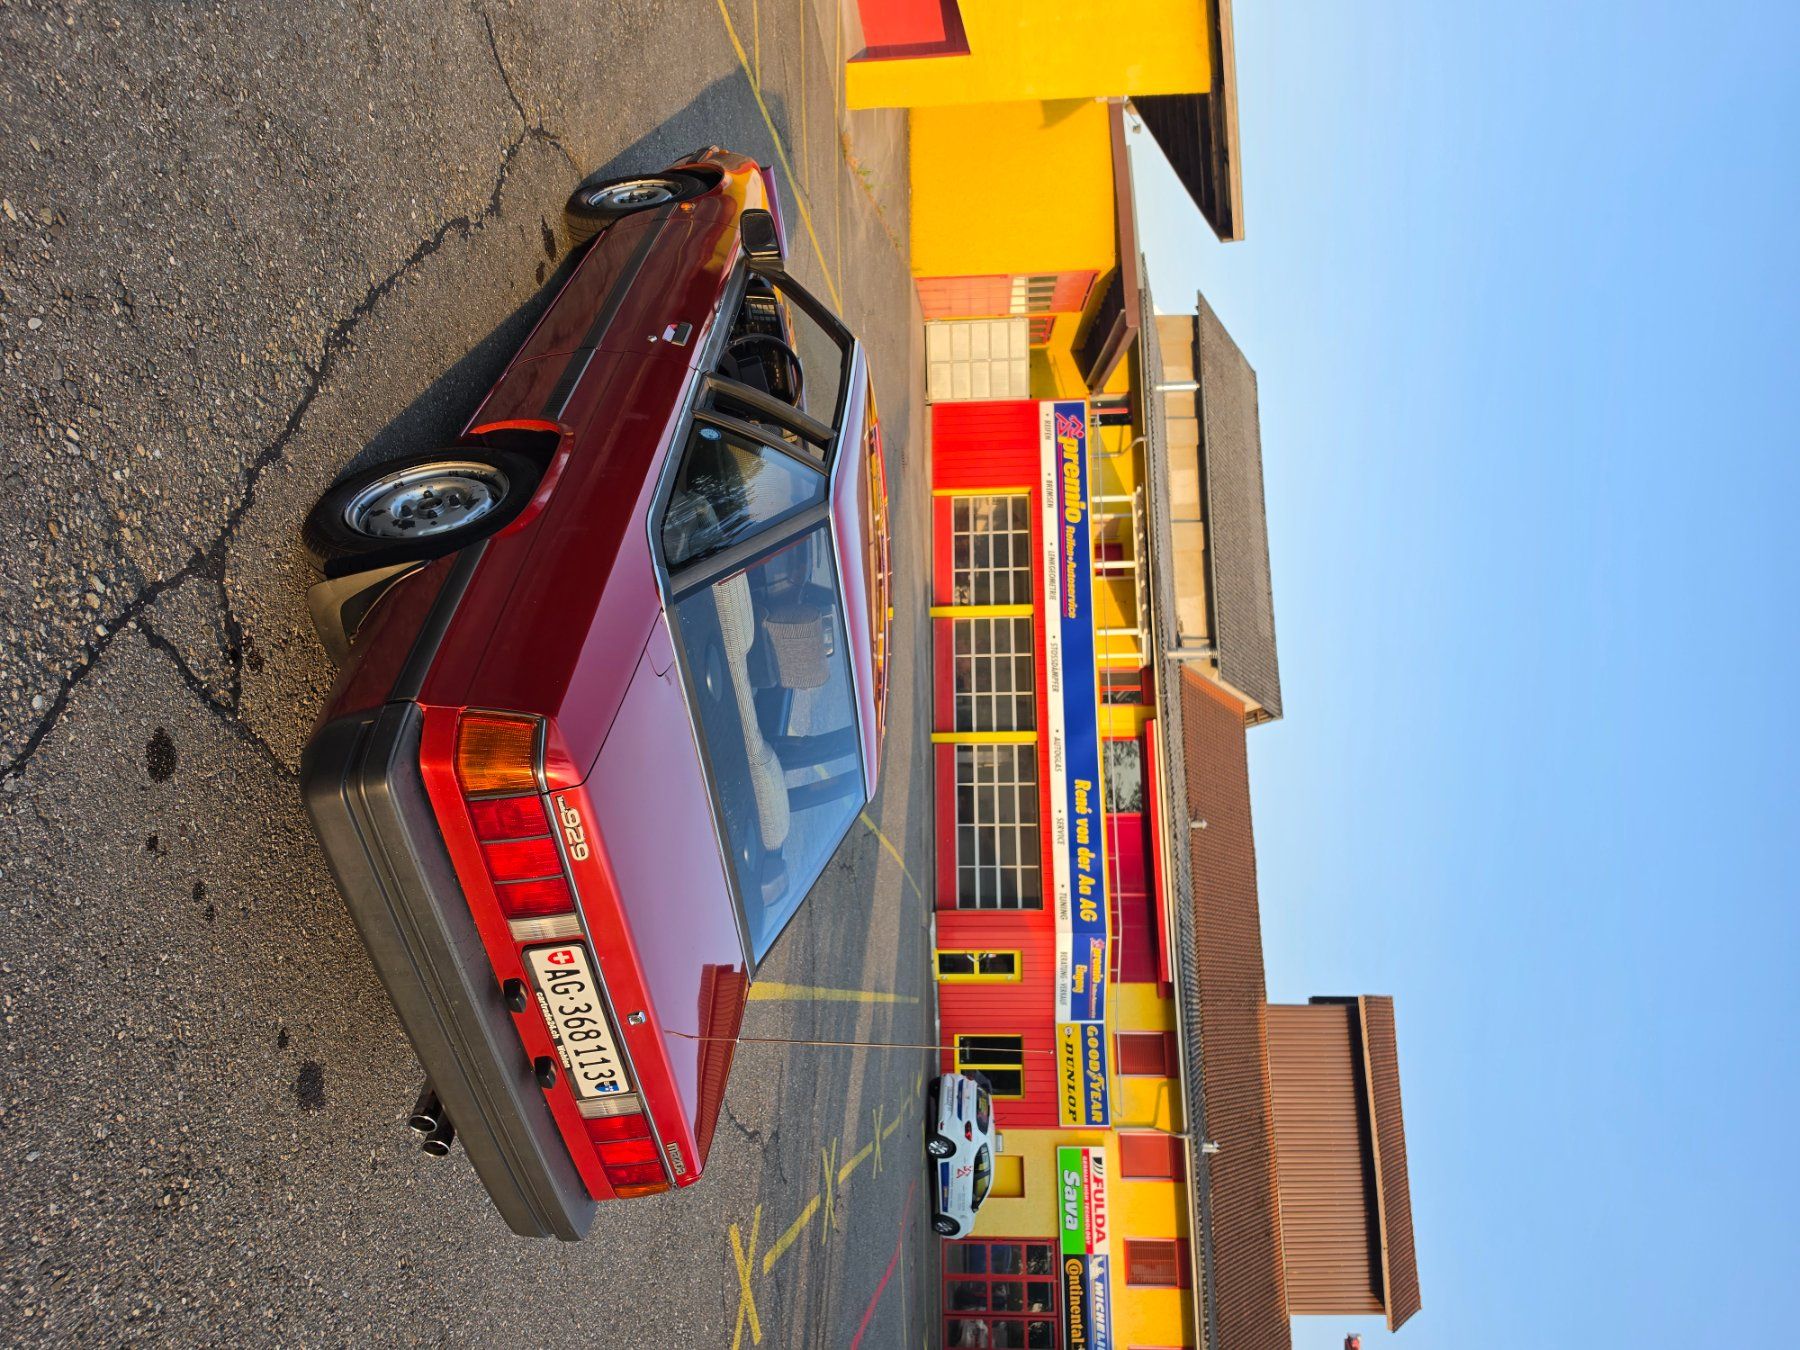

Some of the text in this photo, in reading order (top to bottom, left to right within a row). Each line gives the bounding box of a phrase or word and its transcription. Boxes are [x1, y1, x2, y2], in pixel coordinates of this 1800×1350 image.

[1044, 420, 1052, 440] REIFEN
[1046, 480, 1054, 508] BREMSEN
[1058, 436, 1086, 523] premio
[1048, 550, 1056, 600] LENKGEOMETRIE
[1054, 736, 1062, 772] AUTOGLAS
[561, 808, 590, 861] 929
[1056, 818, 1065, 846] SERVICE
[1074, 779, 1098, 922] René von der Aa AG
[1059, 892, 1068, 920] TUNING
[1060, 952, 1068, 979] BERATUNG
[536, 992, 571, 1069] cartrade24.ch Wohlen
[1065, 1042, 1076, 1122] DUNLOP
[1086, 1025, 1104, 1123] GOODYEAR
[1064, 1170, 1080, 1231] Sava
[1093, 1174, 1106, 1244] FULDA
[1066, 1258, 1086, 1344] Continental
